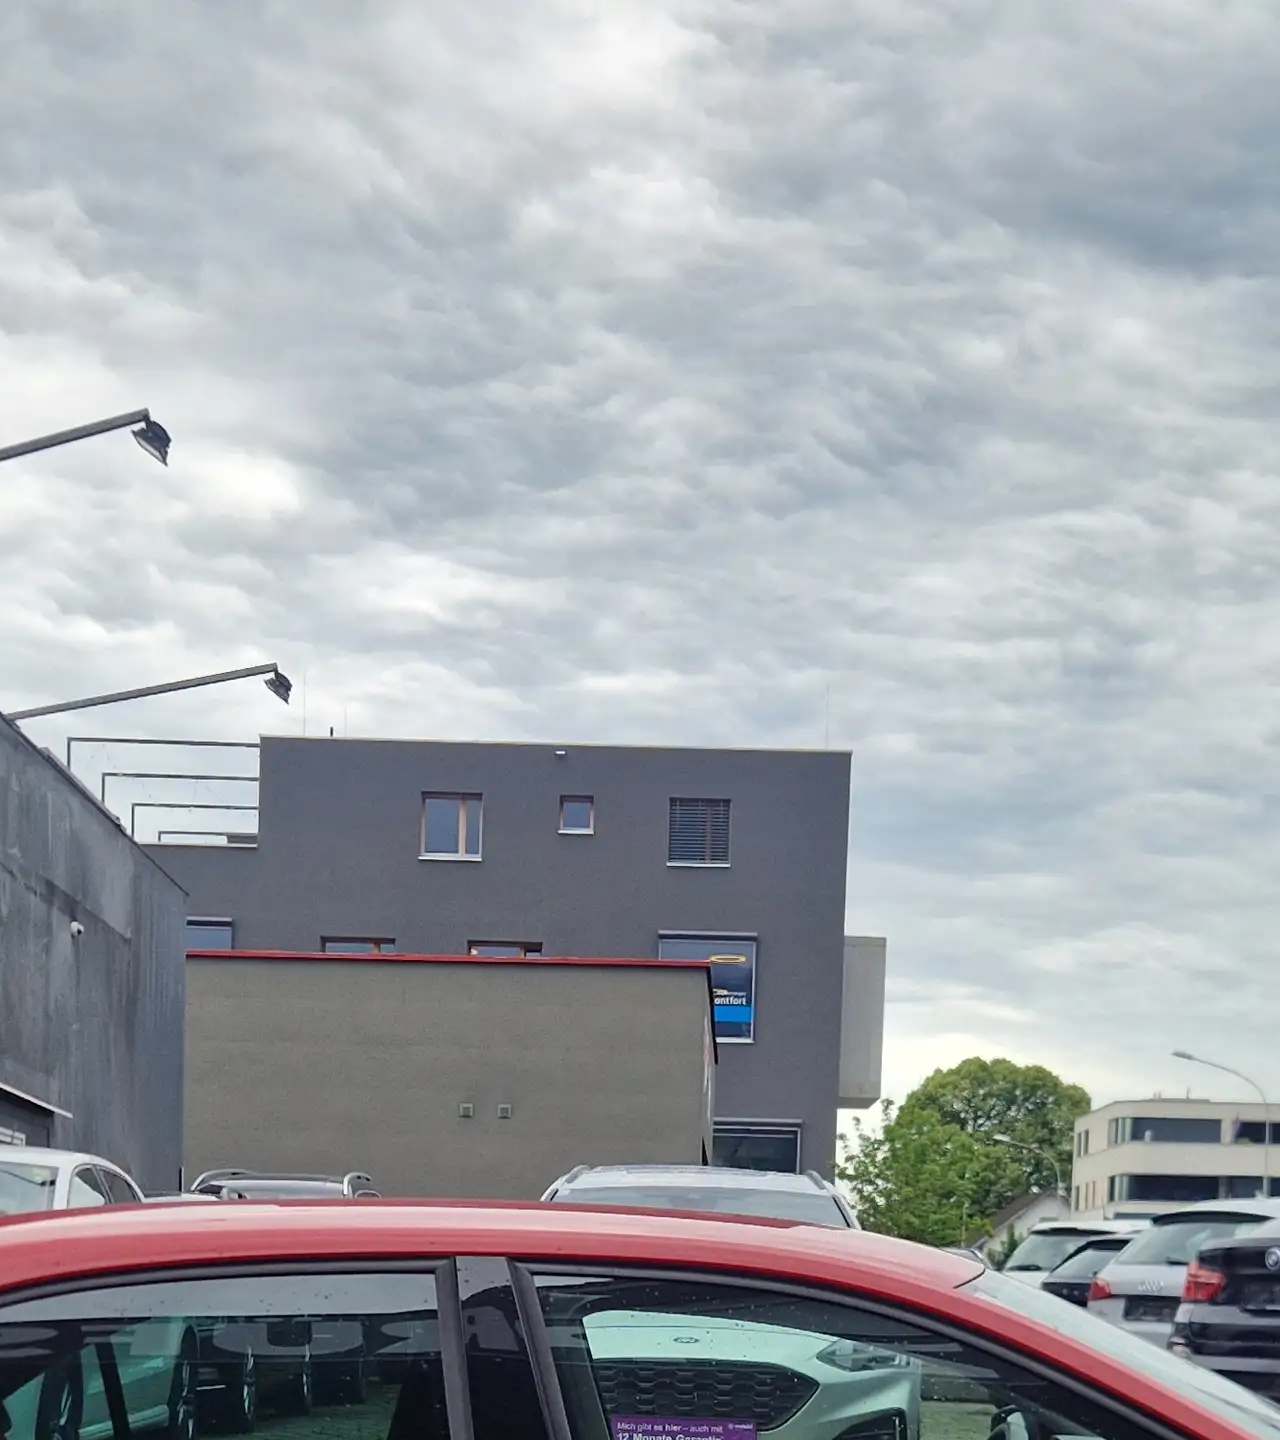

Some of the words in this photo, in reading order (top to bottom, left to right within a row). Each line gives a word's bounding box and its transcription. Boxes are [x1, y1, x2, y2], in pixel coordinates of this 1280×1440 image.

[714, 996, 747, 1005] ontfort
[617, 1422, 635, 1430] Mich
[637, 1423, 651, 1432] gibt
[711, 1425, 723, 1433] mit
